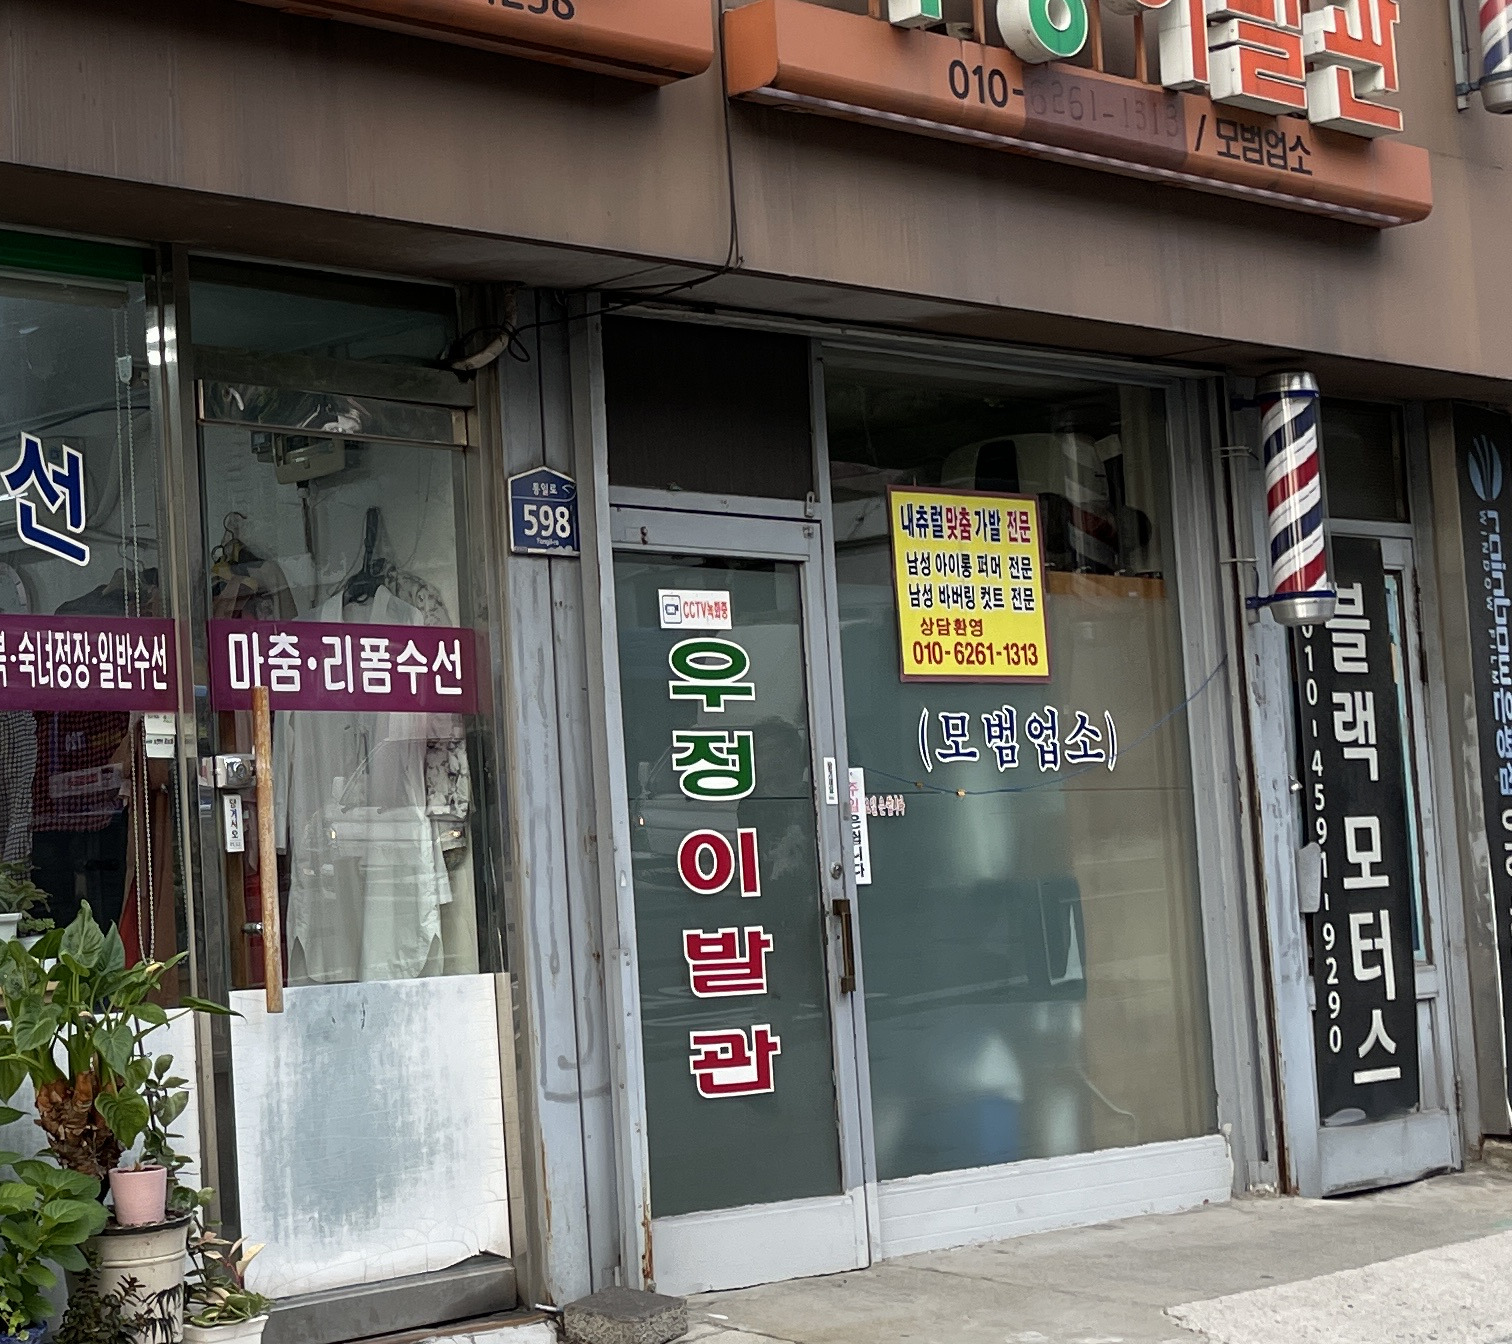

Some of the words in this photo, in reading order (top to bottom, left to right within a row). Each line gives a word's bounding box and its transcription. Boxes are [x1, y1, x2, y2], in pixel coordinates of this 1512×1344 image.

[1215, 117, 1313, 176] 모범업소
[523, 504, 571, 538] 598
[1006, 510, 1031, 543] 전문
[906, 551, 931, 577] 남성
[935, 552, 973, 579] 아이롱
[977, 554, 1002, 580] 퍼머
[1008, 555, 1033, 580] 전문
[909, 583, 934, 609] 남성
[938, 584, 976, 610] 바버링
[980, 585, 1005, 610] 컷트
[1011, 587, 1035, 611] 전문
[1479, 510, 1494, 612] WINDOW
[1488, 629, 1500, 685] FILM
[920, 617, 984, 638] 상담환영
[912, 640, 1039, 666] 010-6261-1313
[668, 637, 782, 1099] 우정이발관
[1343, 816, 1402, 1085] 모터스
